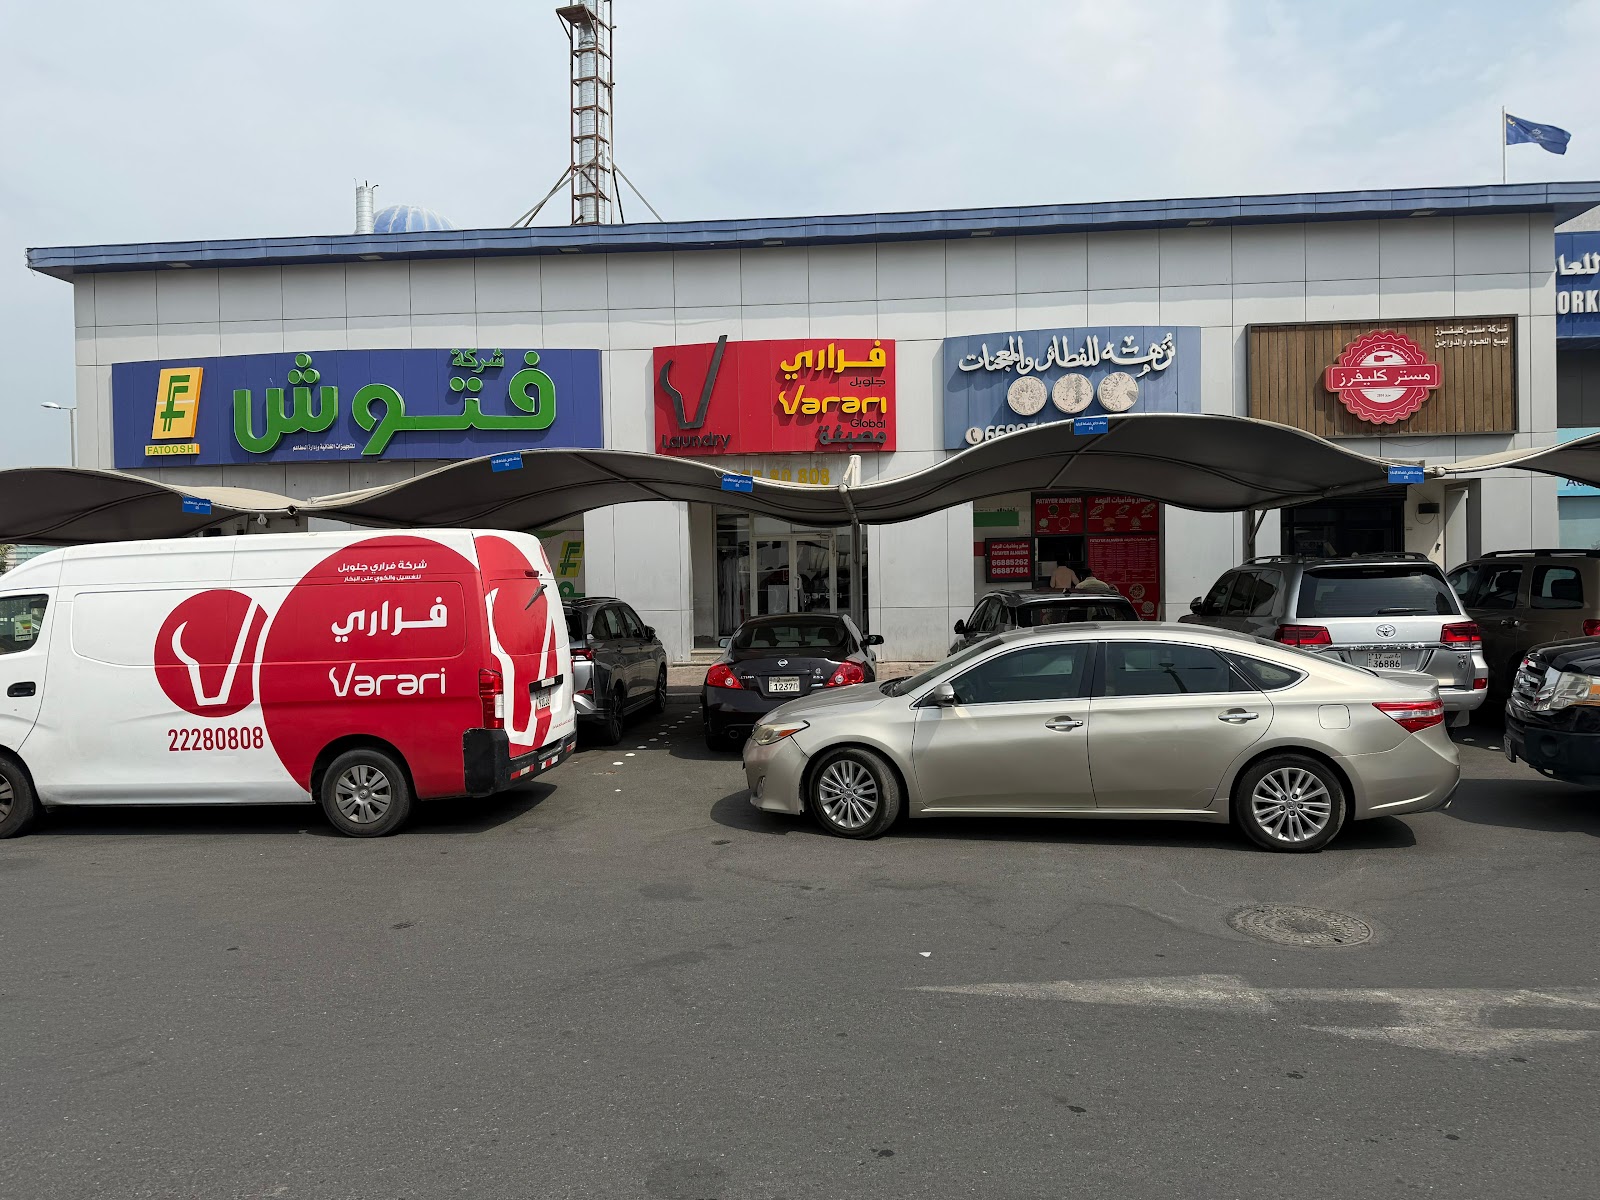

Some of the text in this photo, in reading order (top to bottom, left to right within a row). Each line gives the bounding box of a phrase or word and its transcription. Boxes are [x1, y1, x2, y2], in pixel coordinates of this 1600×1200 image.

[1557, 290, 1600, 315] ORK
[450, 347, 504, 373] شركة
[780, 340, 887, 380] فراري
[850, 377, 886, 387] جلوبل
[1339, 369, 1431, 386] مستر كليفرز
[233, 352, 556, 455] فتوش
[850, 418, 886, 429] Global
[661, 431, 731, 449] Laundry
[819, 424, 887, 450] مصبغة
[147, 445, 194, 454] FATOOSH
[798, 468, 830, 485] 808
[337, 559, 428, 574] شركة فراري جلوبل
[331, 596, 448, 643] فراري
[1373, 660, 1400, 668] 36886
[328, 662, 446, 697] Varari
[167, 726, 264, 751] 22280808
